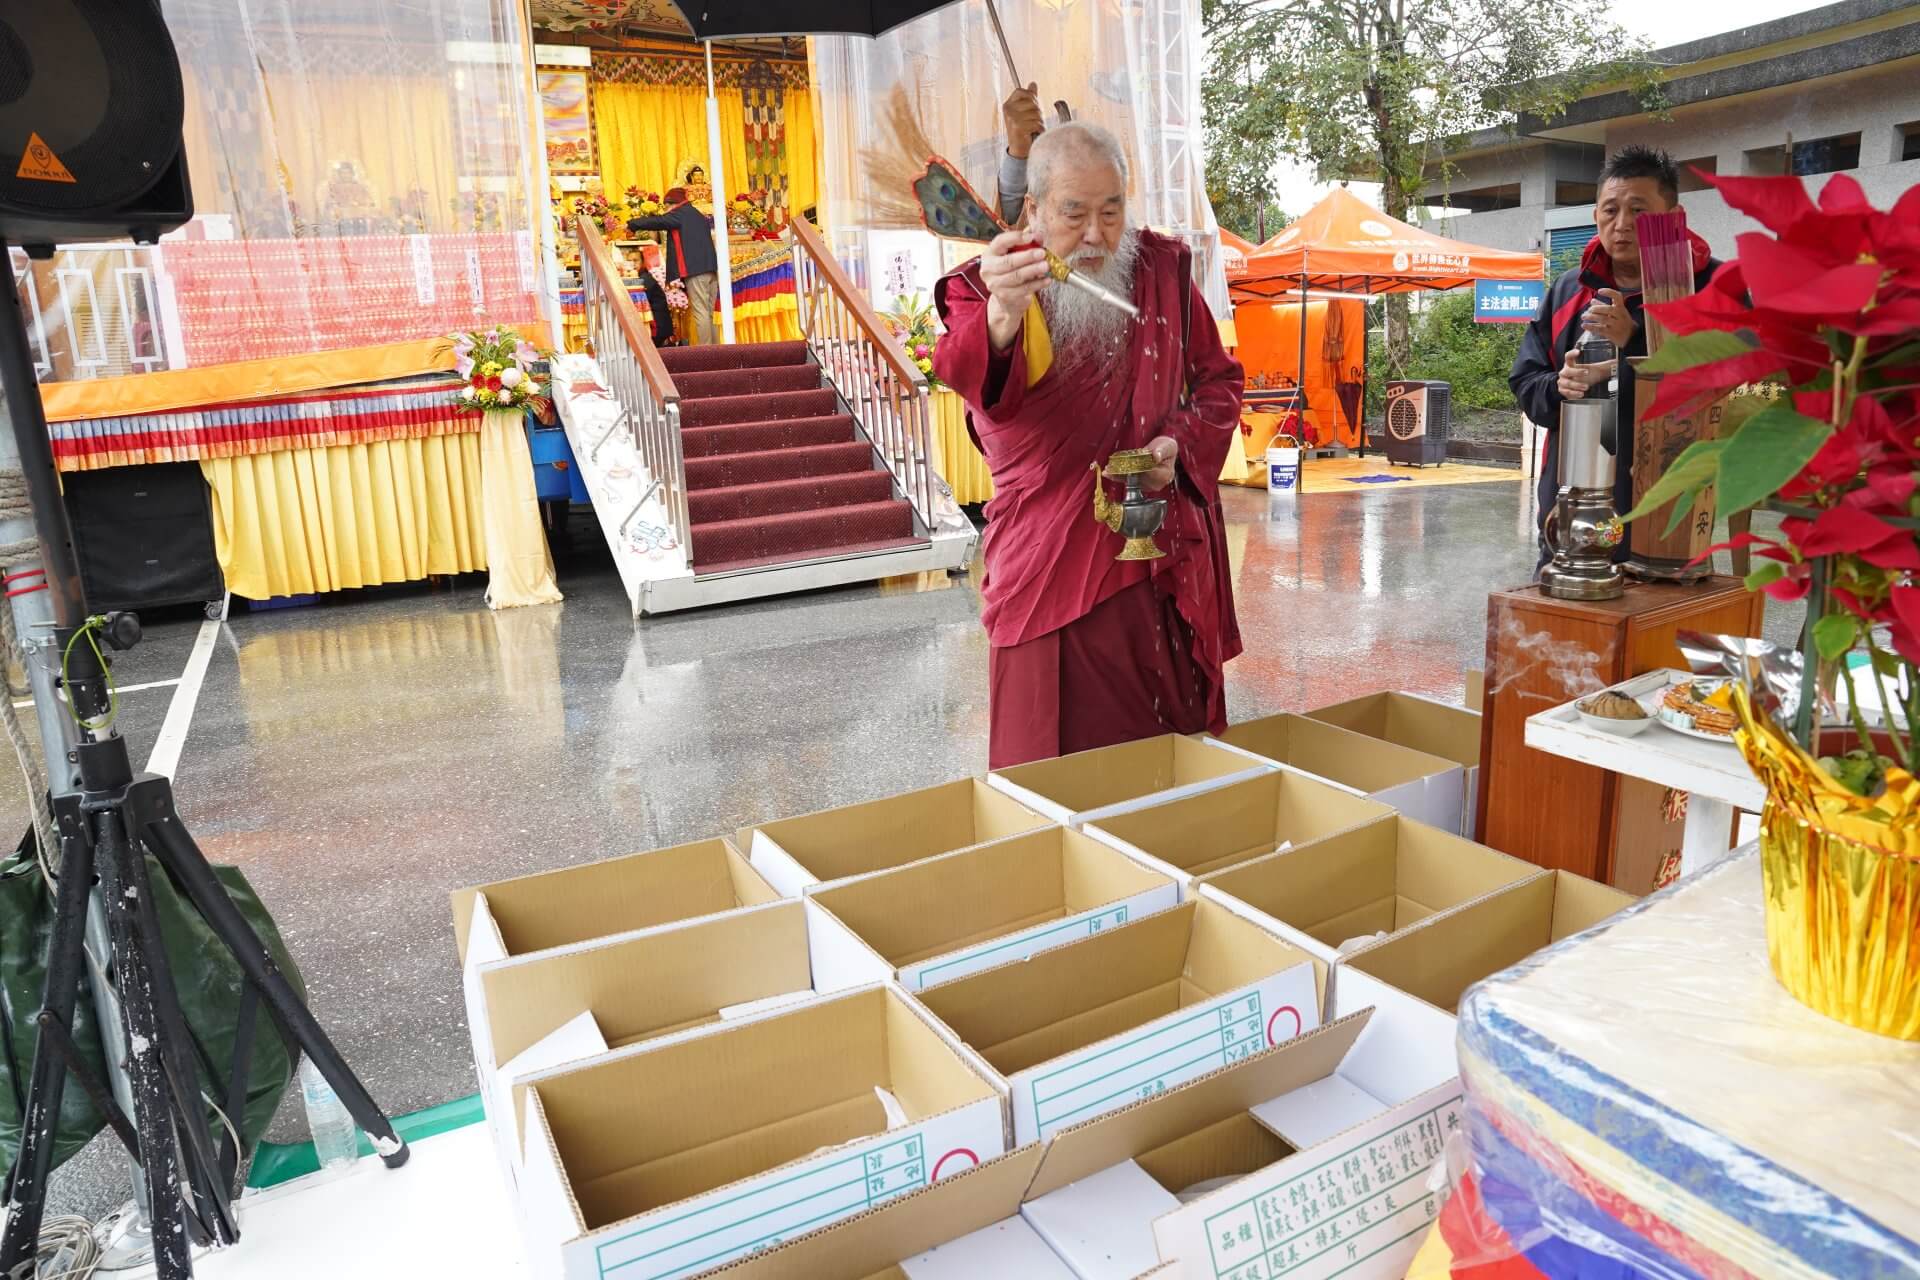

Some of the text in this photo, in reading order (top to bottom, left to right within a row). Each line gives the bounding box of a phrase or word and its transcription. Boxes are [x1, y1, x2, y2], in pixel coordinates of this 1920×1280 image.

[1481, 296, 1539, 311] 主法金剛上師
[1221, 1221, 1254, 1250] 品種
[1346, 1243, 1358, 1261] 斤
